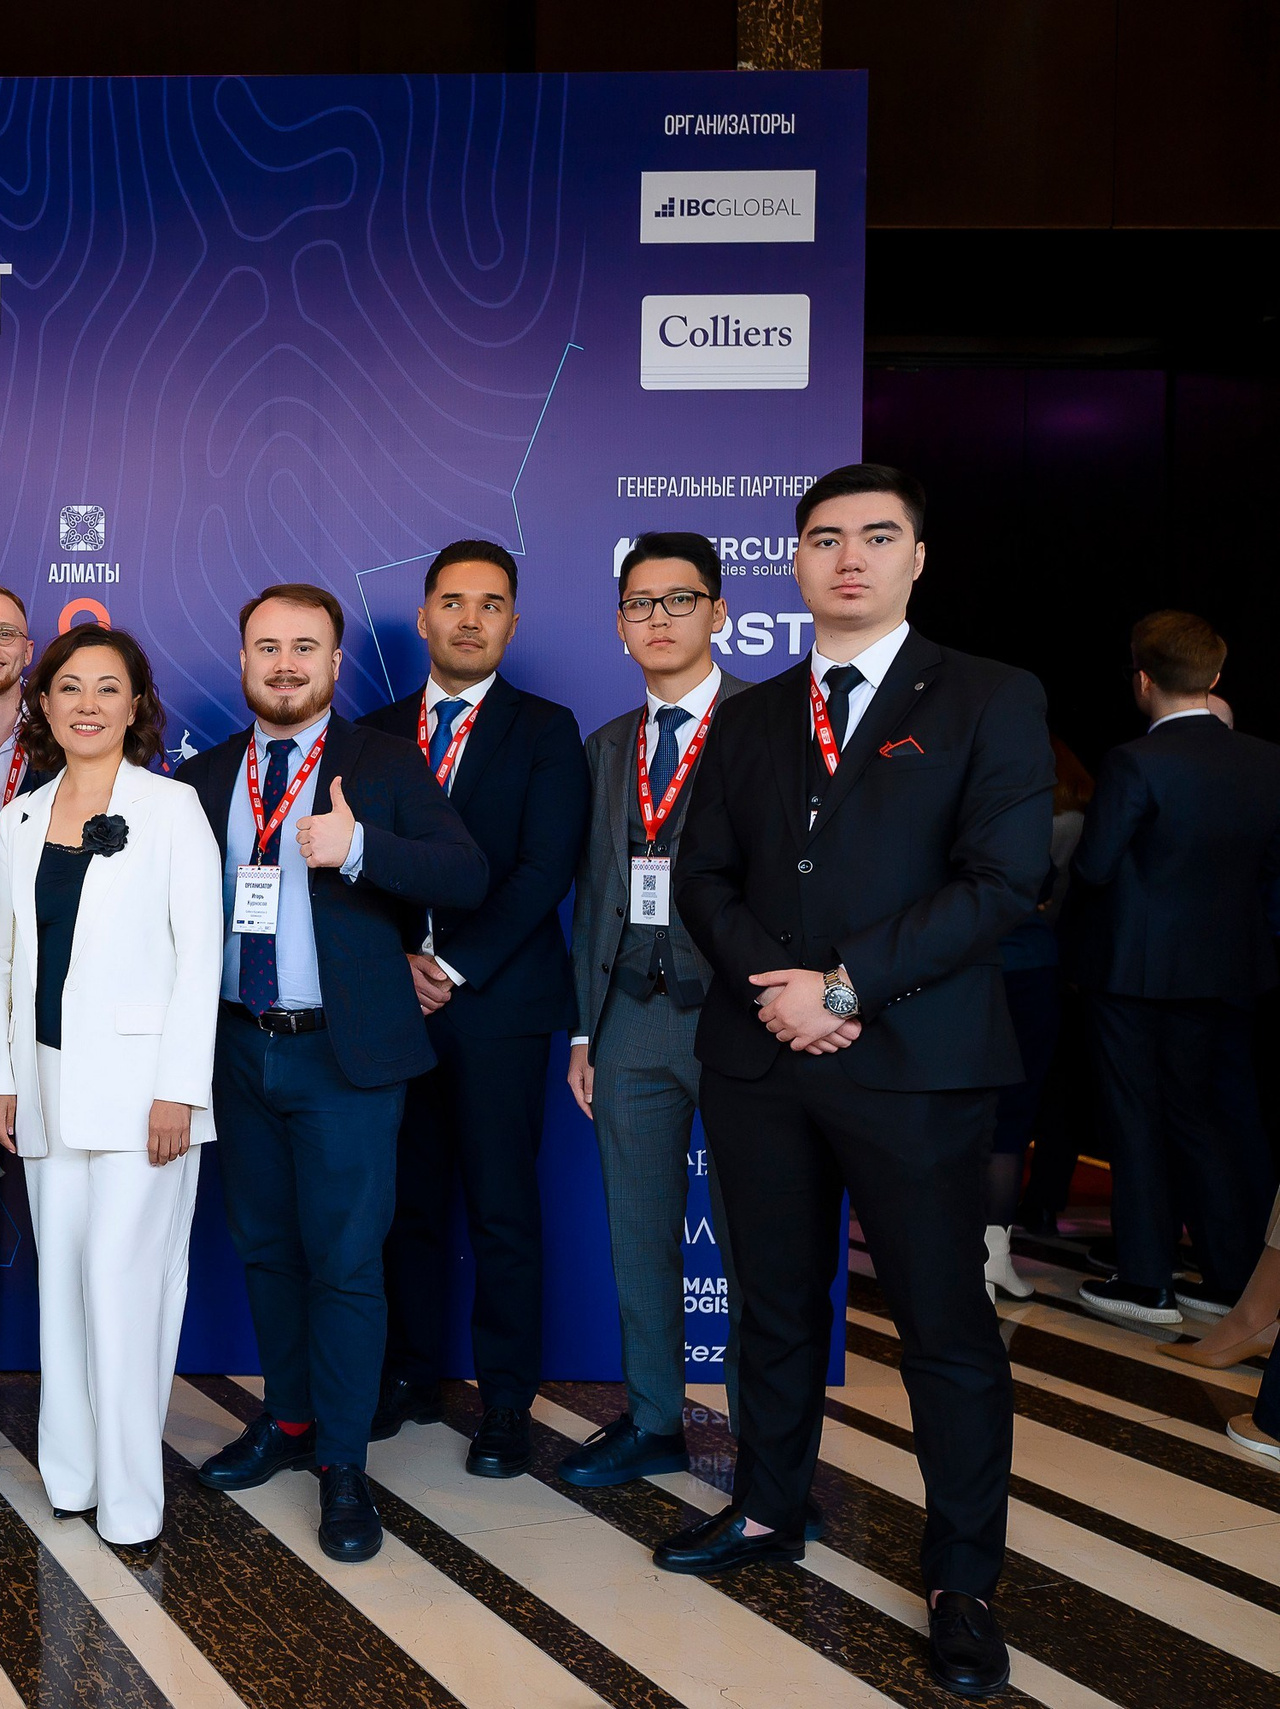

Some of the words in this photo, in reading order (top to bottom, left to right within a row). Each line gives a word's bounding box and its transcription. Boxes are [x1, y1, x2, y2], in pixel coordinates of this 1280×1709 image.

[664, 114, 795, 135] ОРГАНИЗАТОРЫ
[658, 314, 793, 347] Colliers
[617, 476, 736, 497] ГЕНЕРАЛЬНЫЕ
[48, 563, 120, 583] АЛМАТЫ
